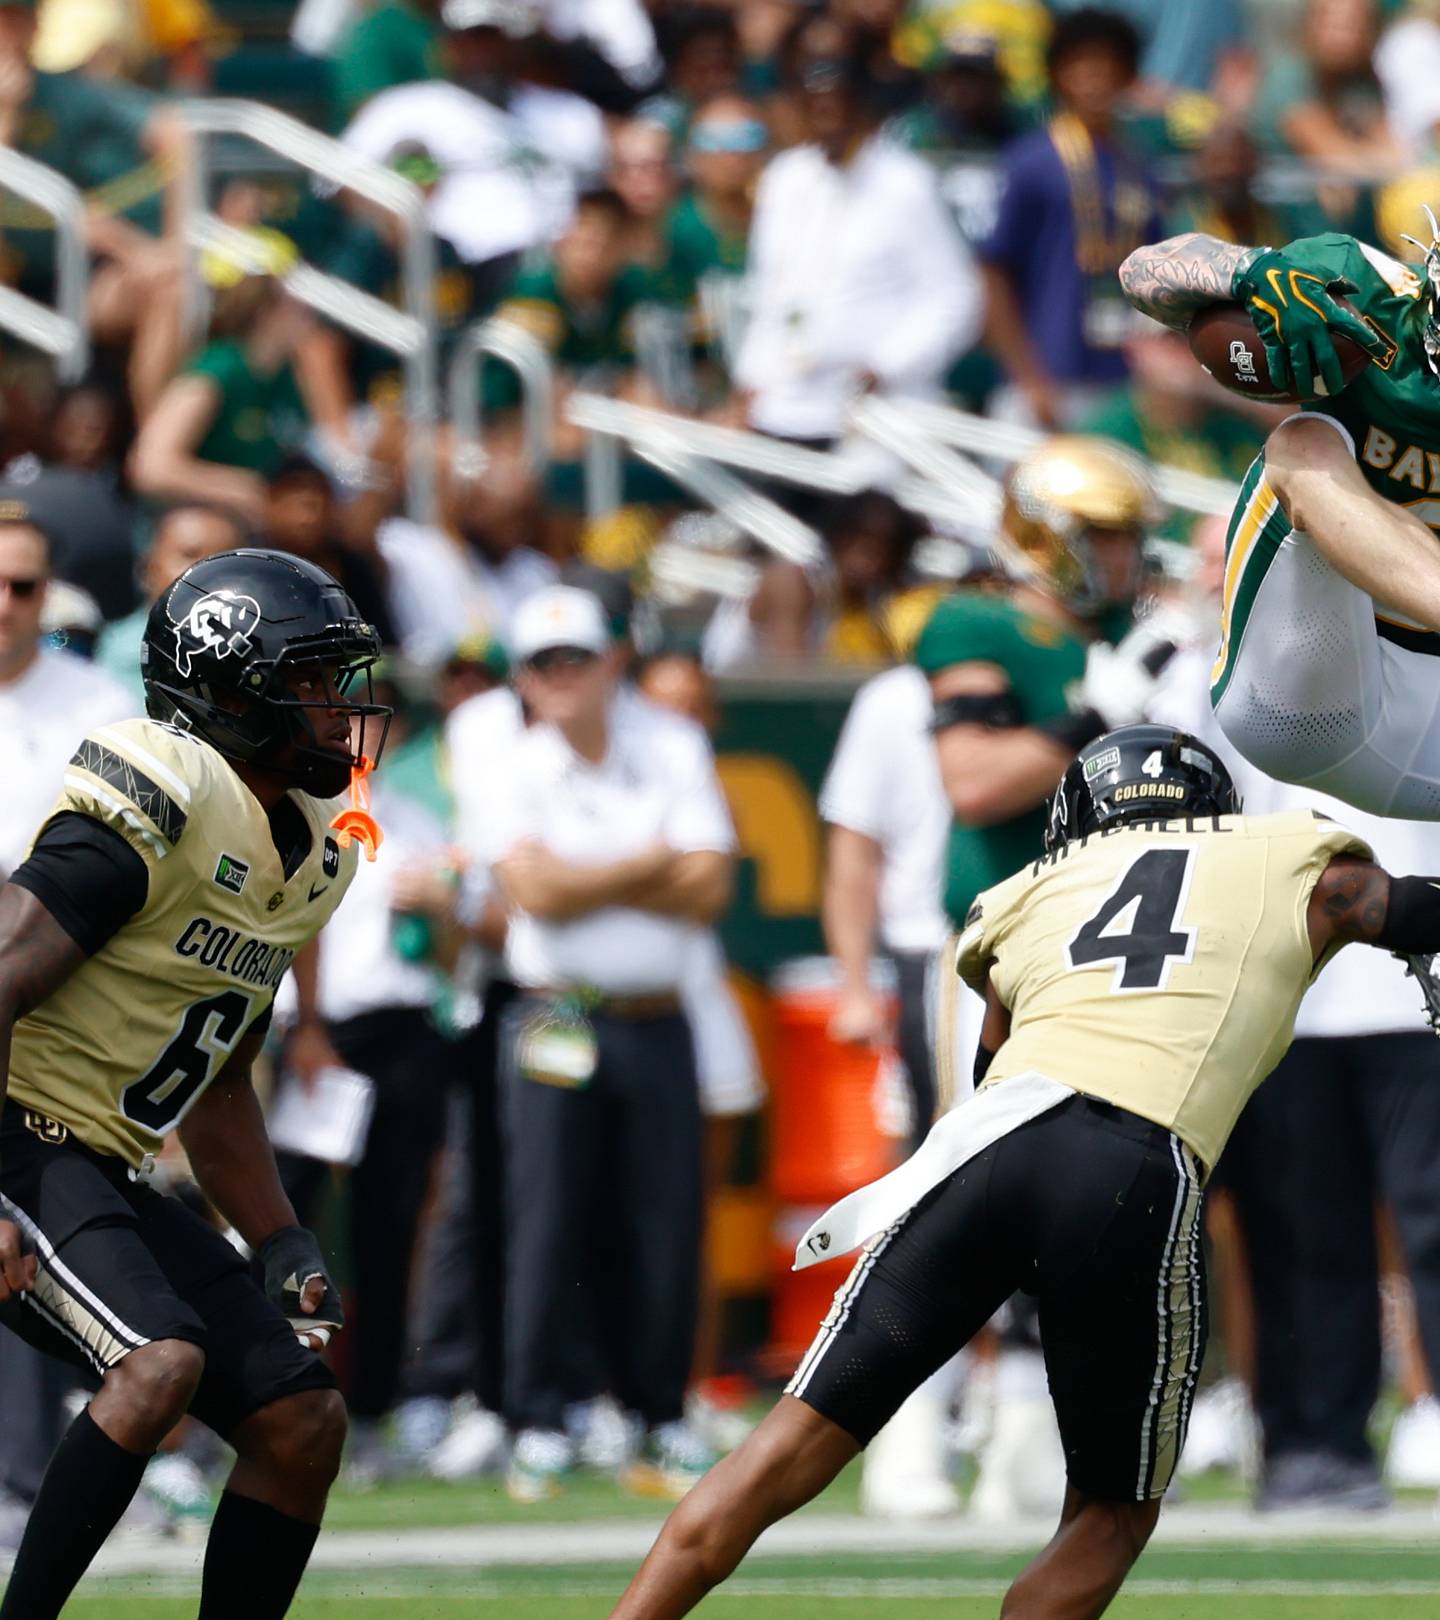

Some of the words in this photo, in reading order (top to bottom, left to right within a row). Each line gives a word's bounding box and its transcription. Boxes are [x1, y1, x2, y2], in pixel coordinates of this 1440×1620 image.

[1114, 783, 1185, 802] COLORADO
[1141, 750, 1164, 778] 4
[1064, 845, 1198, 993] 4
[120, 987, 253, 1136] 6
